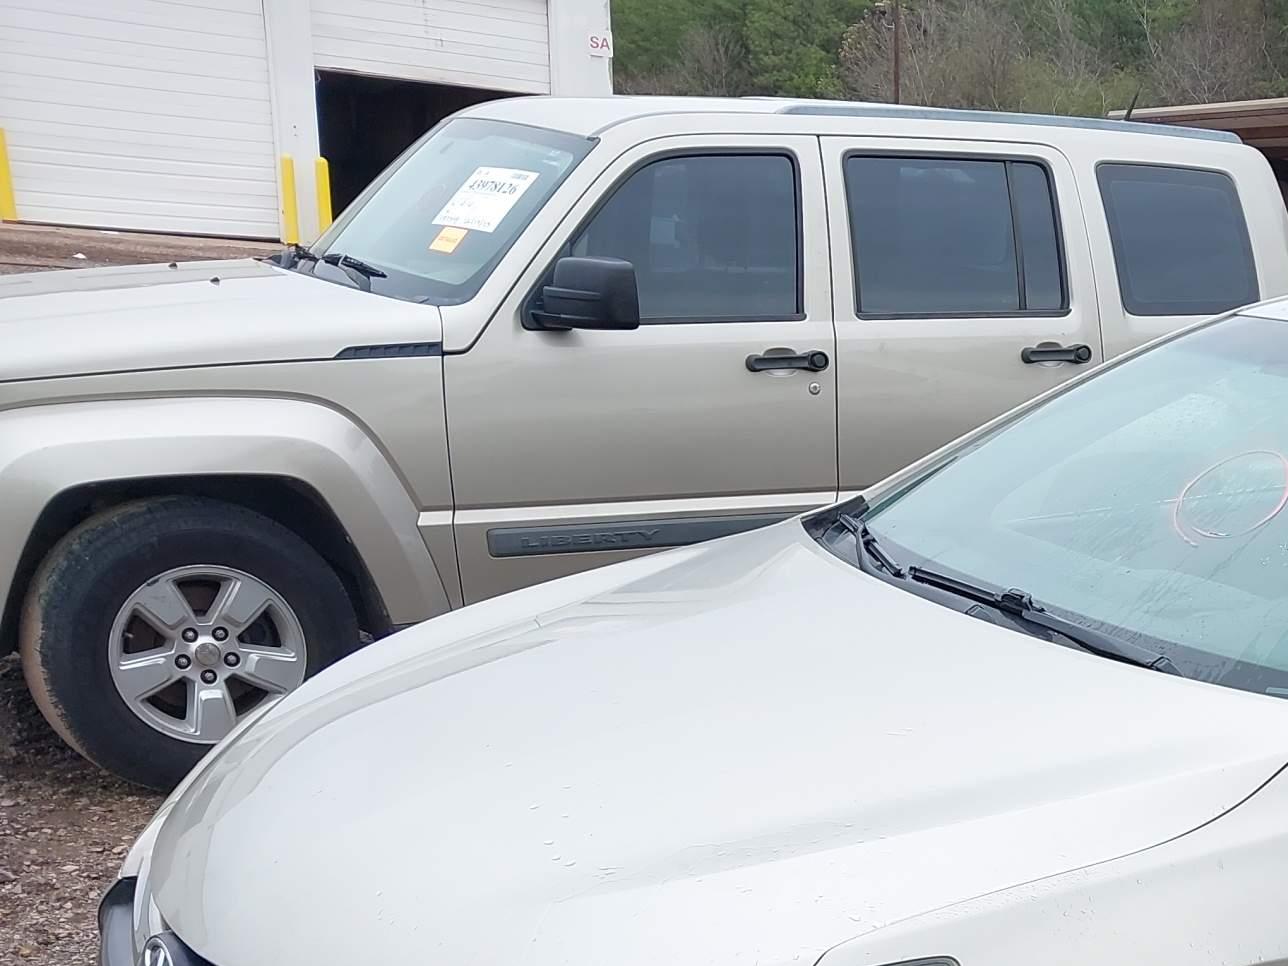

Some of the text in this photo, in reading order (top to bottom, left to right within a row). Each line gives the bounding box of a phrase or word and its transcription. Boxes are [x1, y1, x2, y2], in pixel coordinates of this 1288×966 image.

[590, 36, 610, 50] SA
[469, 179, 519, 195] 43978126
[521, 528, 659, 549] LIBERTY
